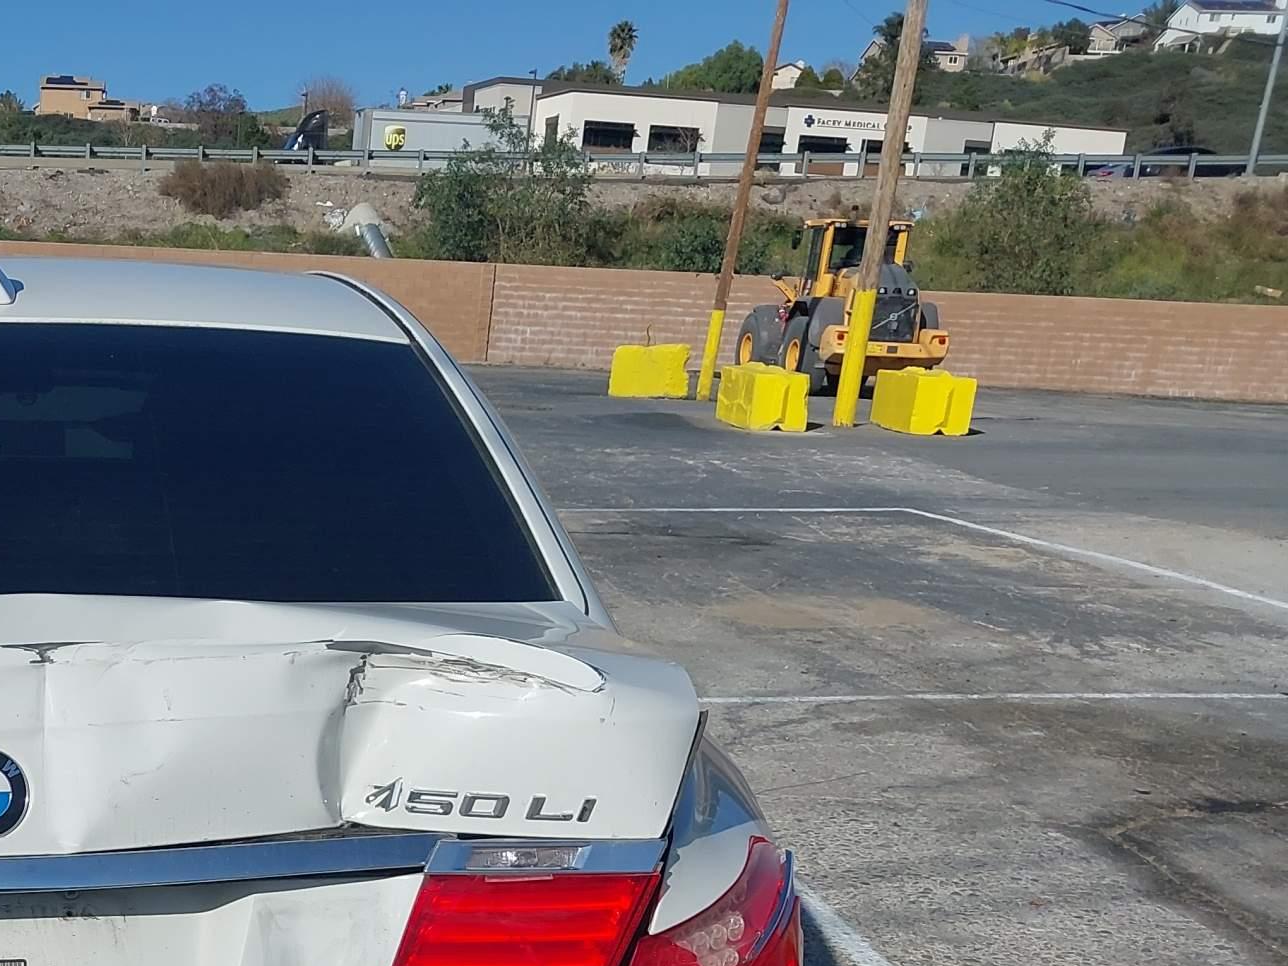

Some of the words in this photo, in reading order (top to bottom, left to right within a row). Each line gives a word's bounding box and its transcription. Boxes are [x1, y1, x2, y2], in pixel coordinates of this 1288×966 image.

[817, 118, 842, 128] FACEY
[844, 120, 880, 130] MEDICAL
[385, 134, 405, 150] ups
